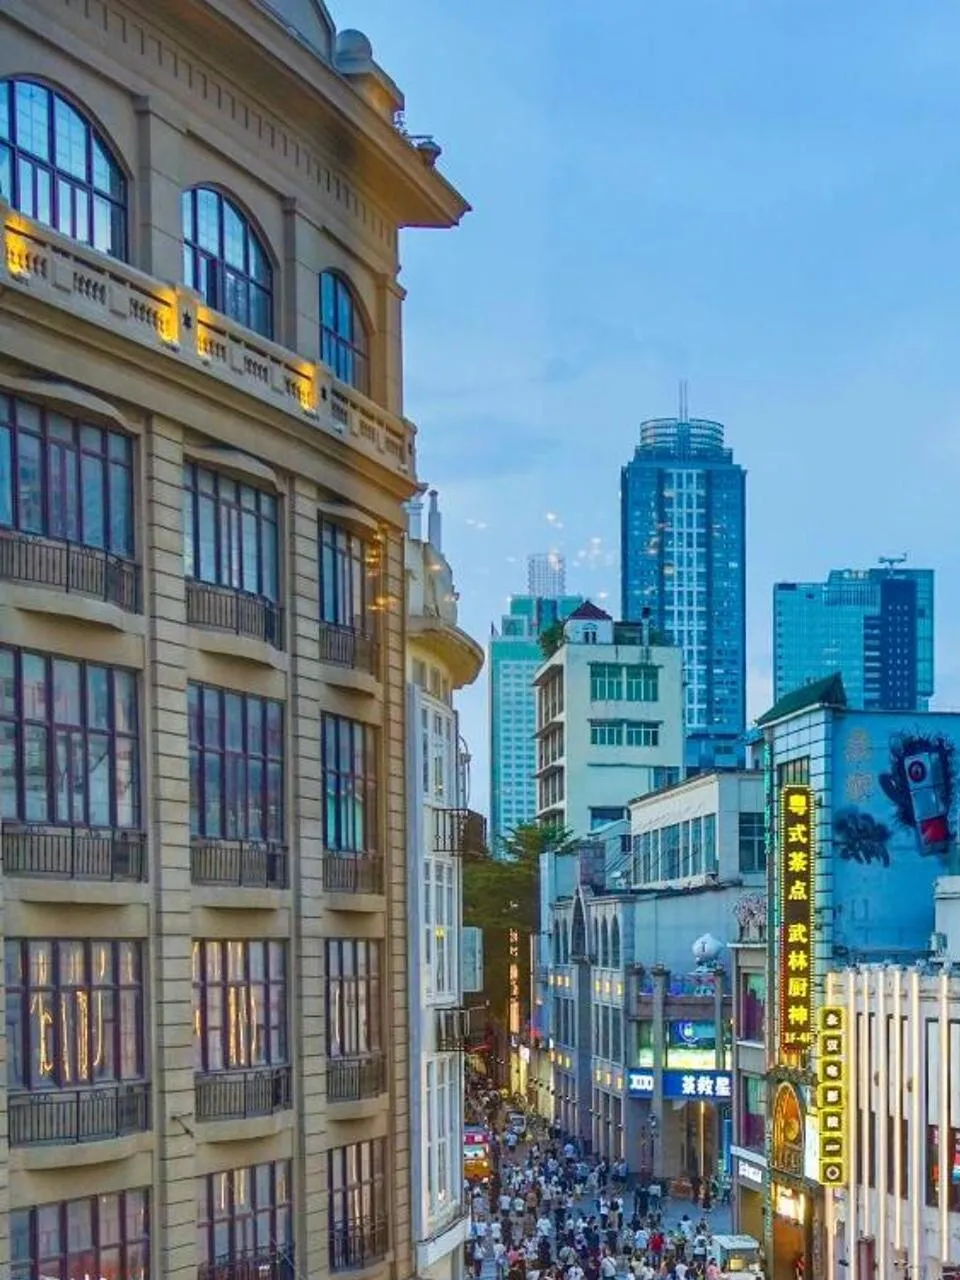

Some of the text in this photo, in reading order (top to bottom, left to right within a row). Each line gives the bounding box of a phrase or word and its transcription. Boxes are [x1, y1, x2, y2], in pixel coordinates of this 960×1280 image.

[787, 794, 808, 1025] 粤式茶点 武林厨神
